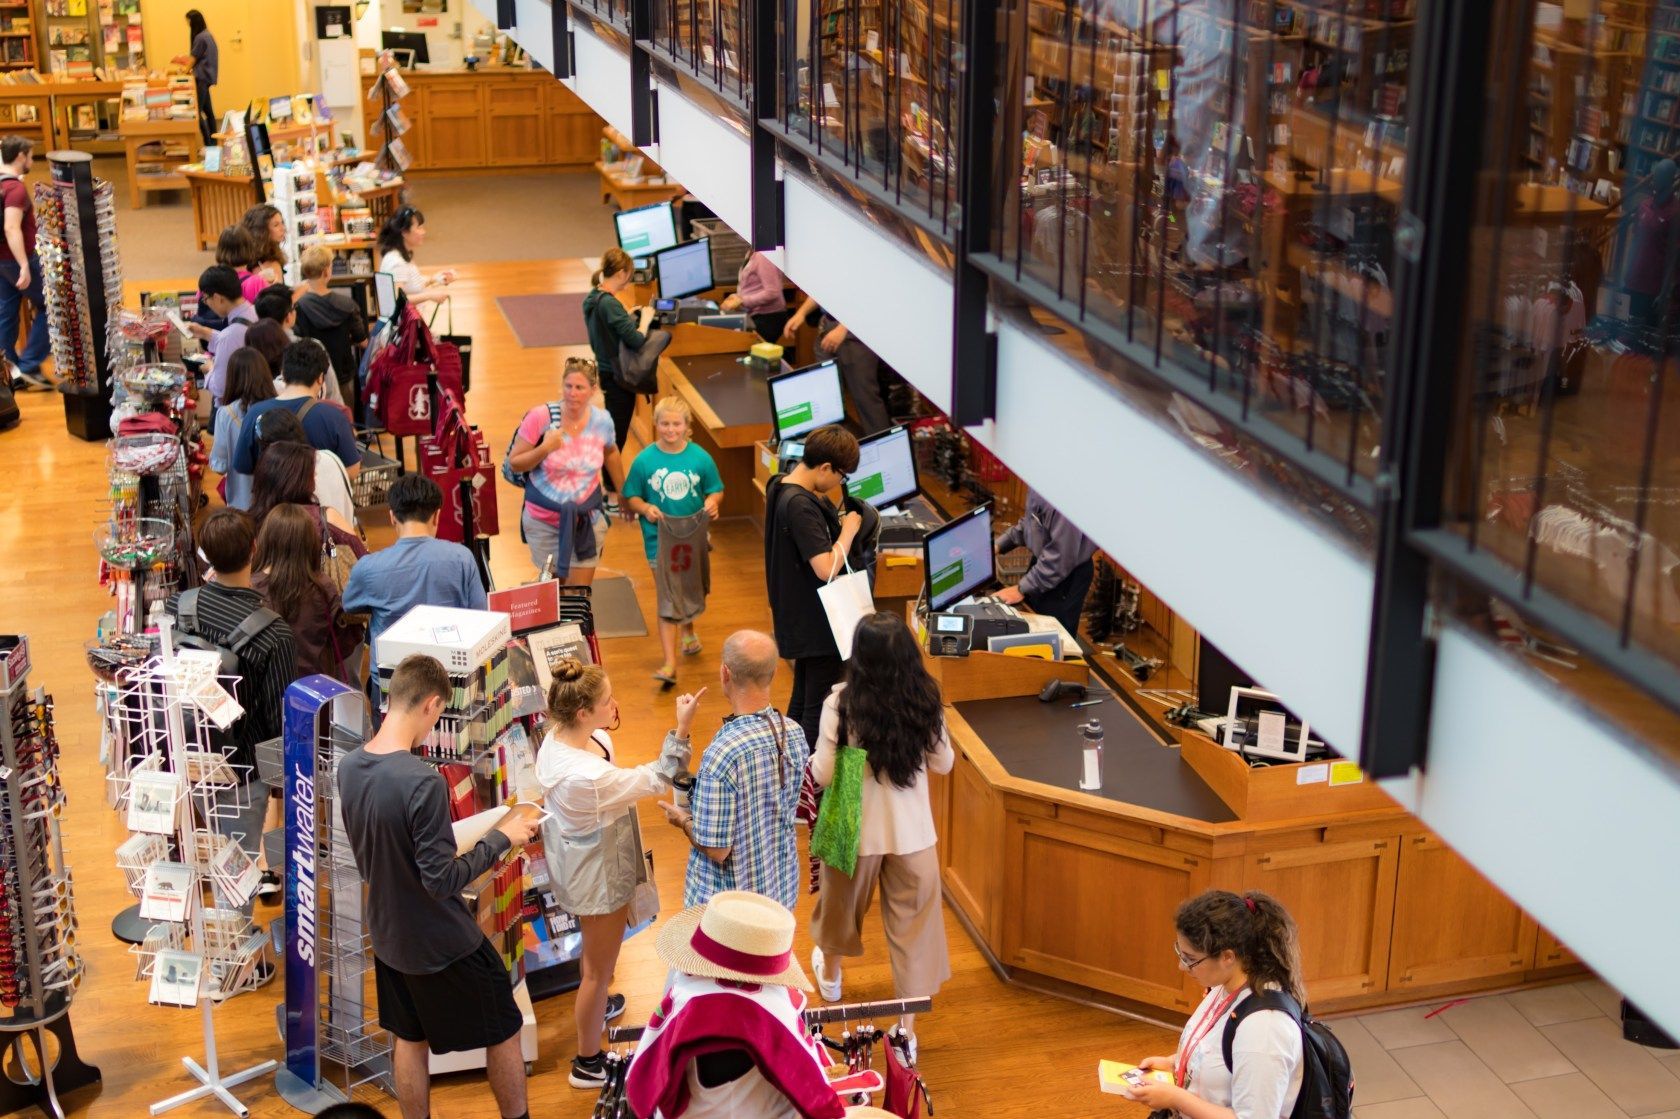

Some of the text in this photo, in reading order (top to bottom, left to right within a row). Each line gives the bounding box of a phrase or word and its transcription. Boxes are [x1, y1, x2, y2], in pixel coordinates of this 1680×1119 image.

[671, 543, 693, 573] S
[510, 599, 538, 610] Featured
[475, 625, 507, 657] MOLESKINE
[291, 762, 315, 968] smartwater
